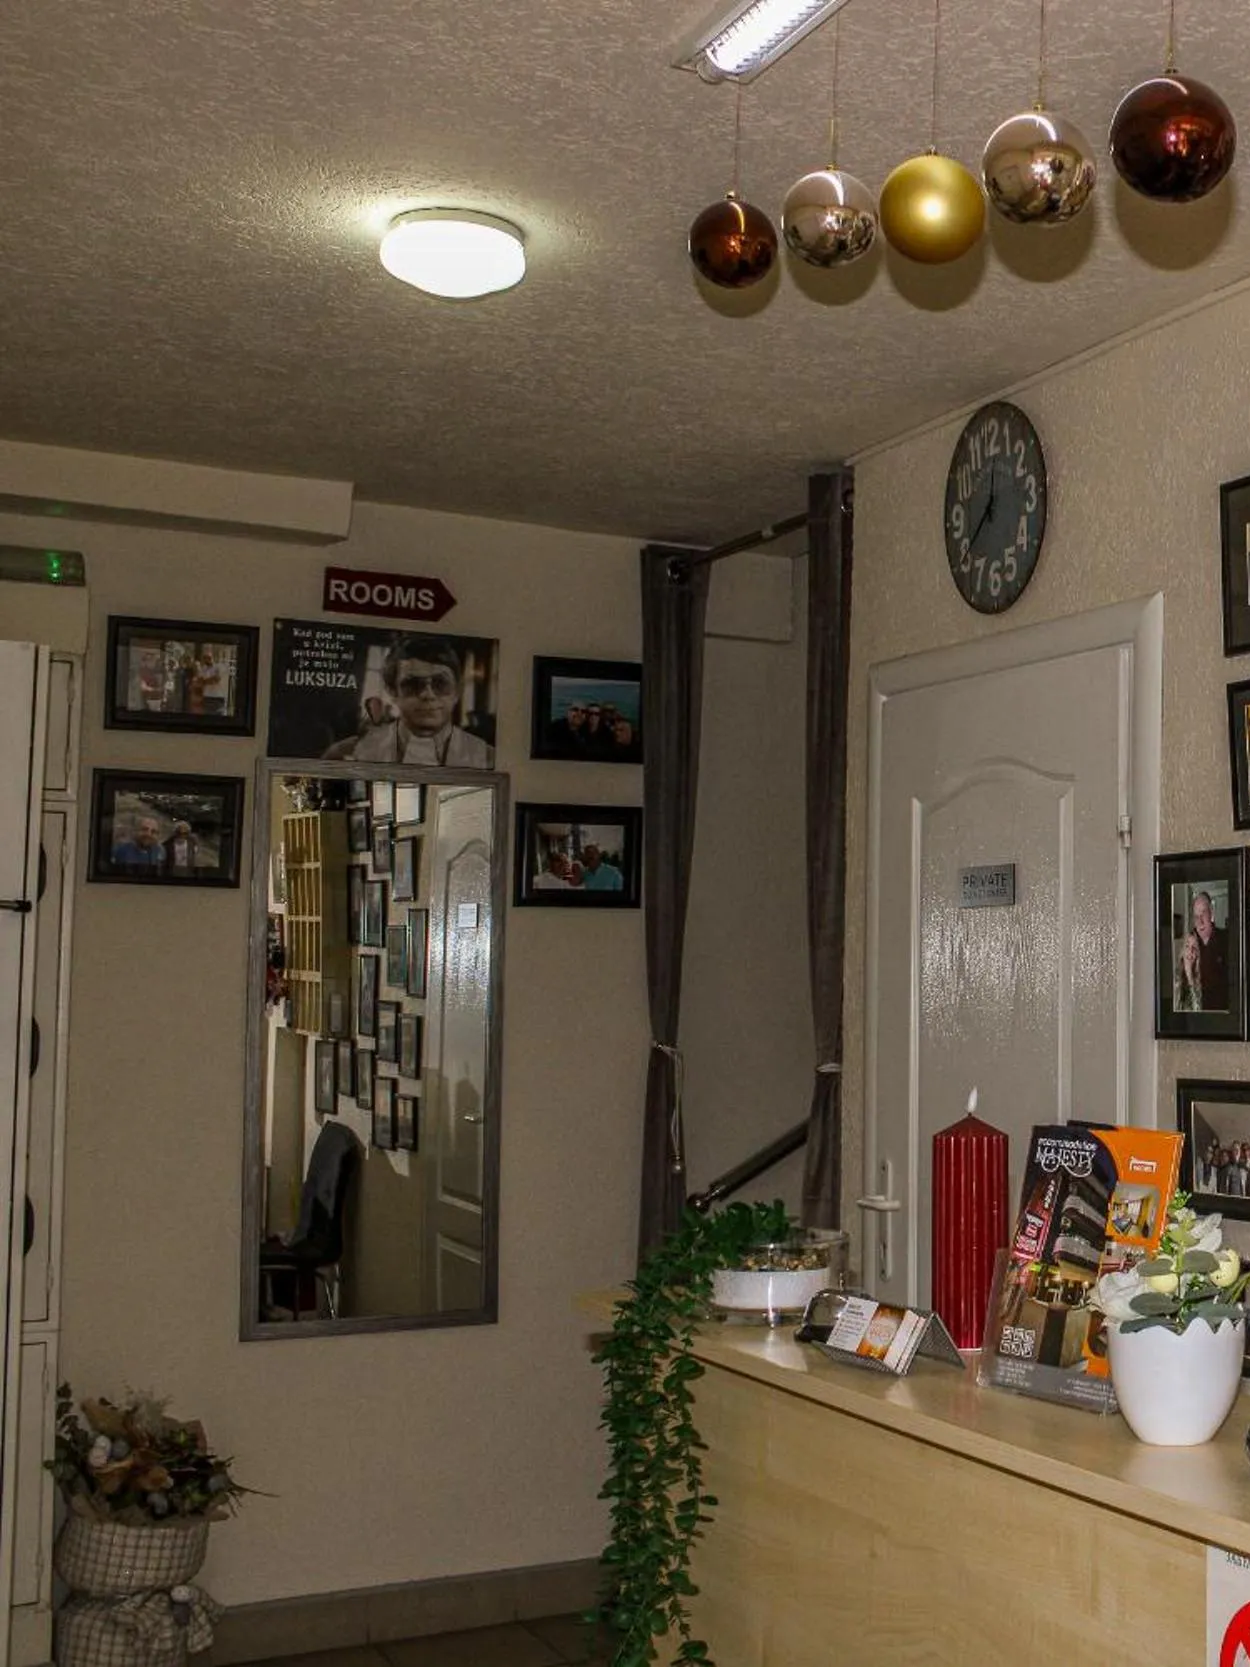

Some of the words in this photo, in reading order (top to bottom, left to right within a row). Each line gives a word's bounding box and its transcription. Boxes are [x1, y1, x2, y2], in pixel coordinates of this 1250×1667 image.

[969, 436, 981, 471] 11
[984, 418, 1000, 456] 12
[1003, 421, 1011, 456] 1
[1015, 439, 1027, 477] 2
[957, 464, 972, 500] 10
[1024, 474, 1037, 512] 3
[952, 505, 965, 539] 9
[1016, 515, 1028, 552] 4
[960, 538, 971, 573] 8
[1004, 545, 1017, 581] 5
[974, 556, 987, 592] 7
[989, 560, 1001, 596] 6
[329, 578, 435, 611] ROOMS
[285, 668, 357, 690] LUKSUZA
